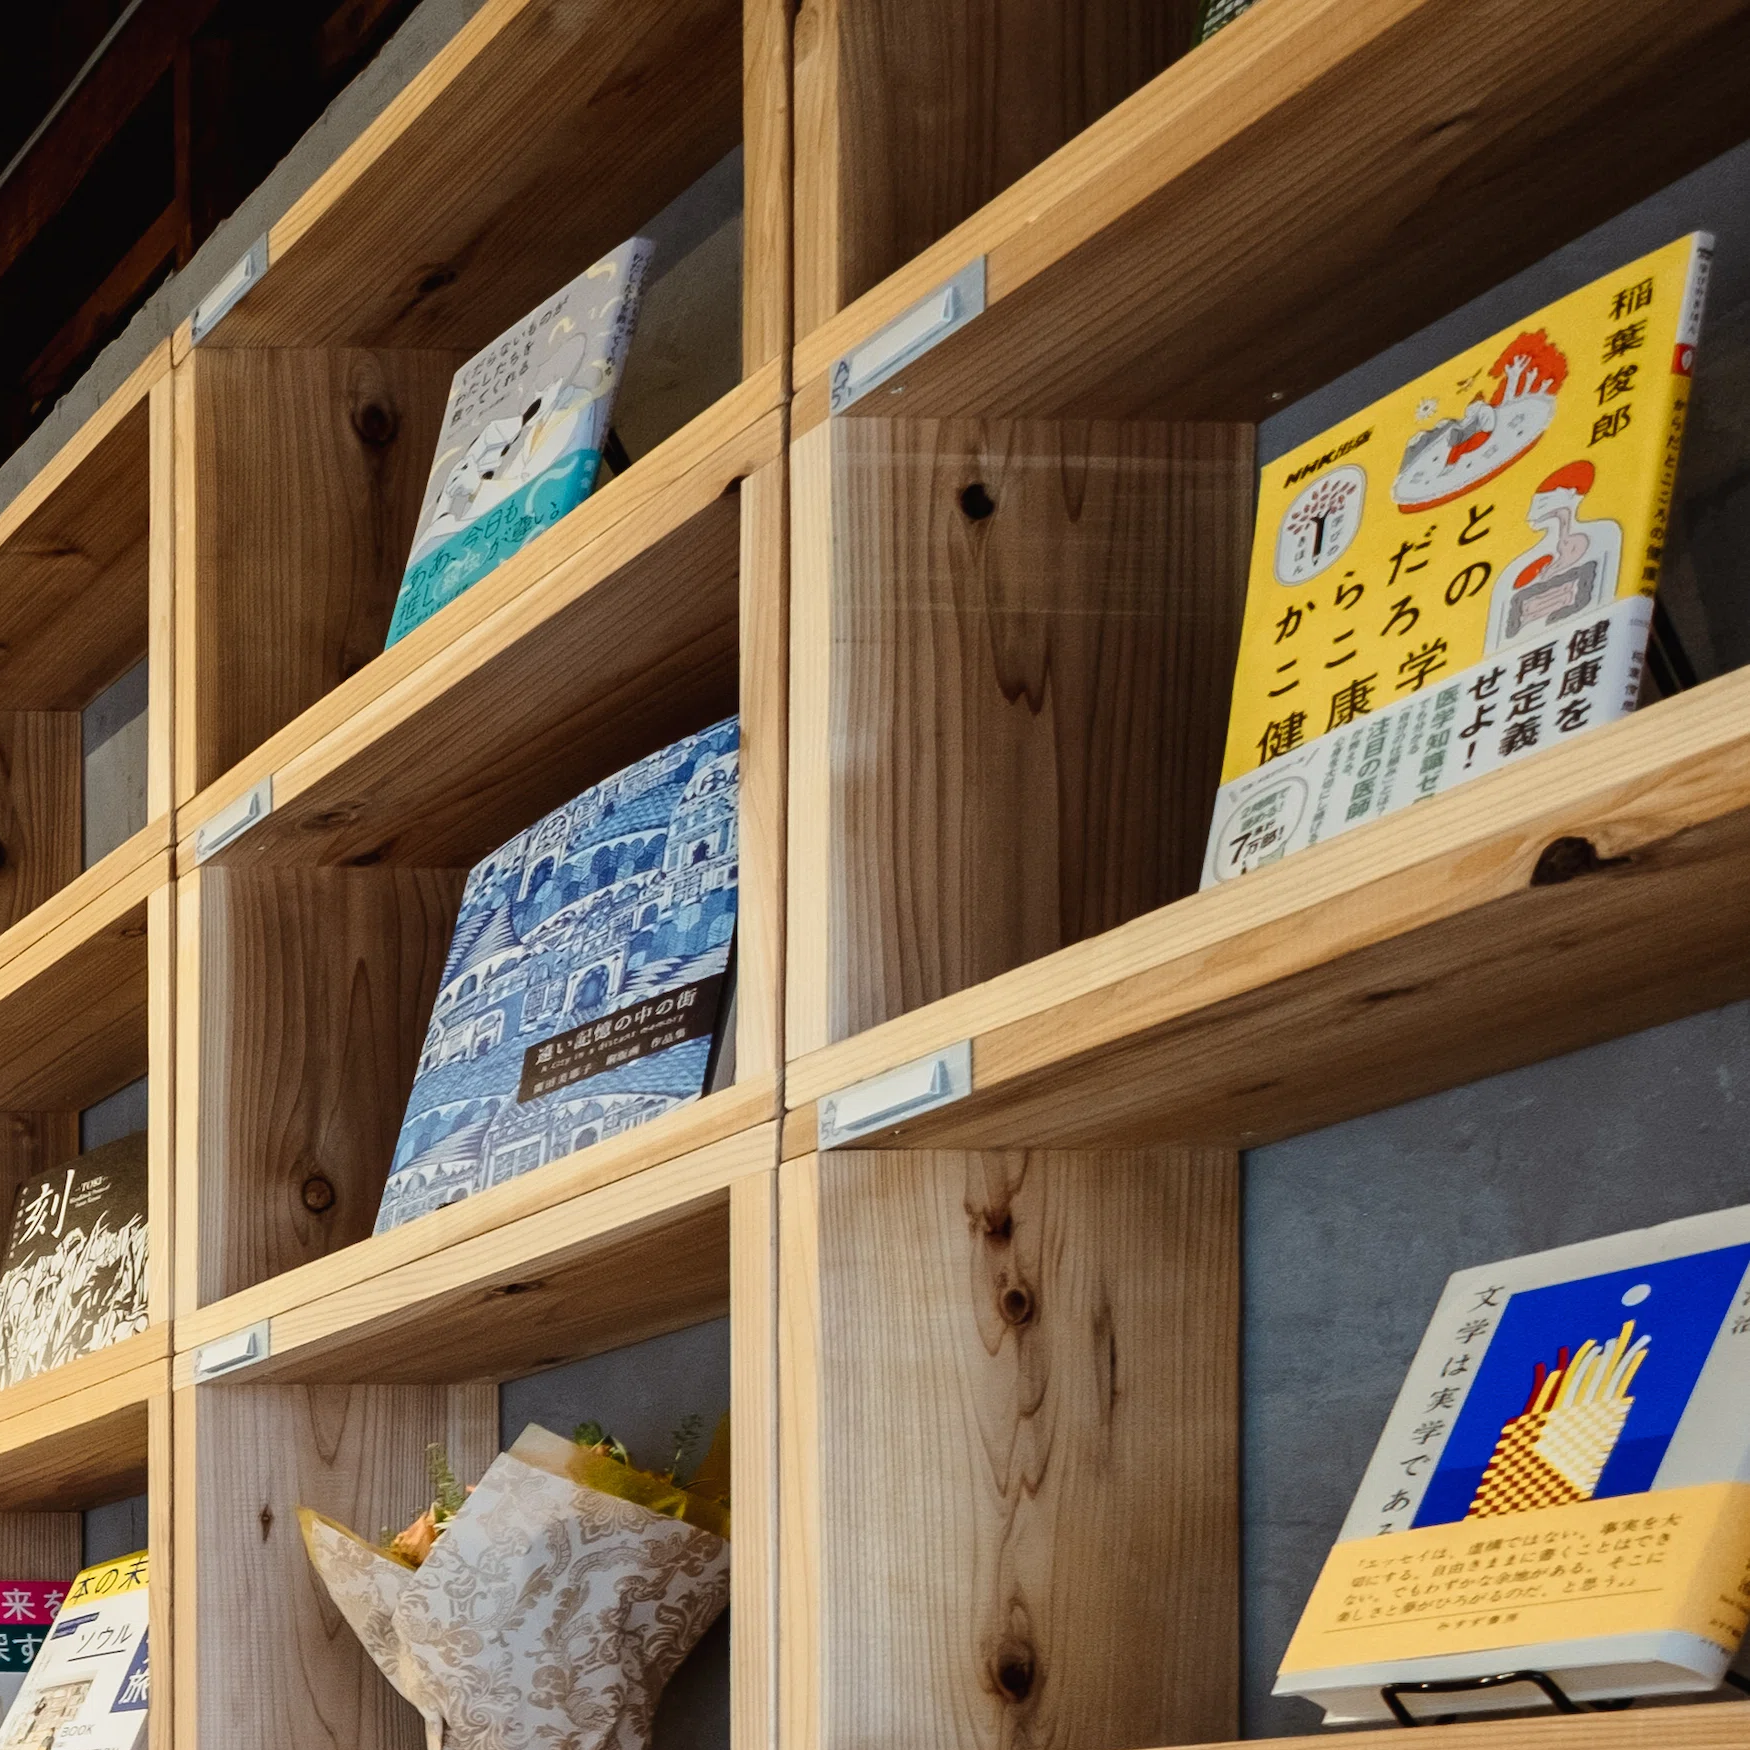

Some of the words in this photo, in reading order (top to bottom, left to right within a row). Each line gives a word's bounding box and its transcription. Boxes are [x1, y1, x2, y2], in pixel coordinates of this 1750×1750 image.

[1587, 277, 1655, 449] 稲葉俊郎
[1267, 560, 1493, 698] こころの
[1276, 503, 1496, 641] からだと
[1257, 640, 1448, 767] 健康学
[1498, 640, 1559, 757] 再定義
[1558, 618, 1611, 733] 健康を
[1412, 685, 1460, 806] 医学知識ゼ
[61, 1723, 95, 1737] BOOK
